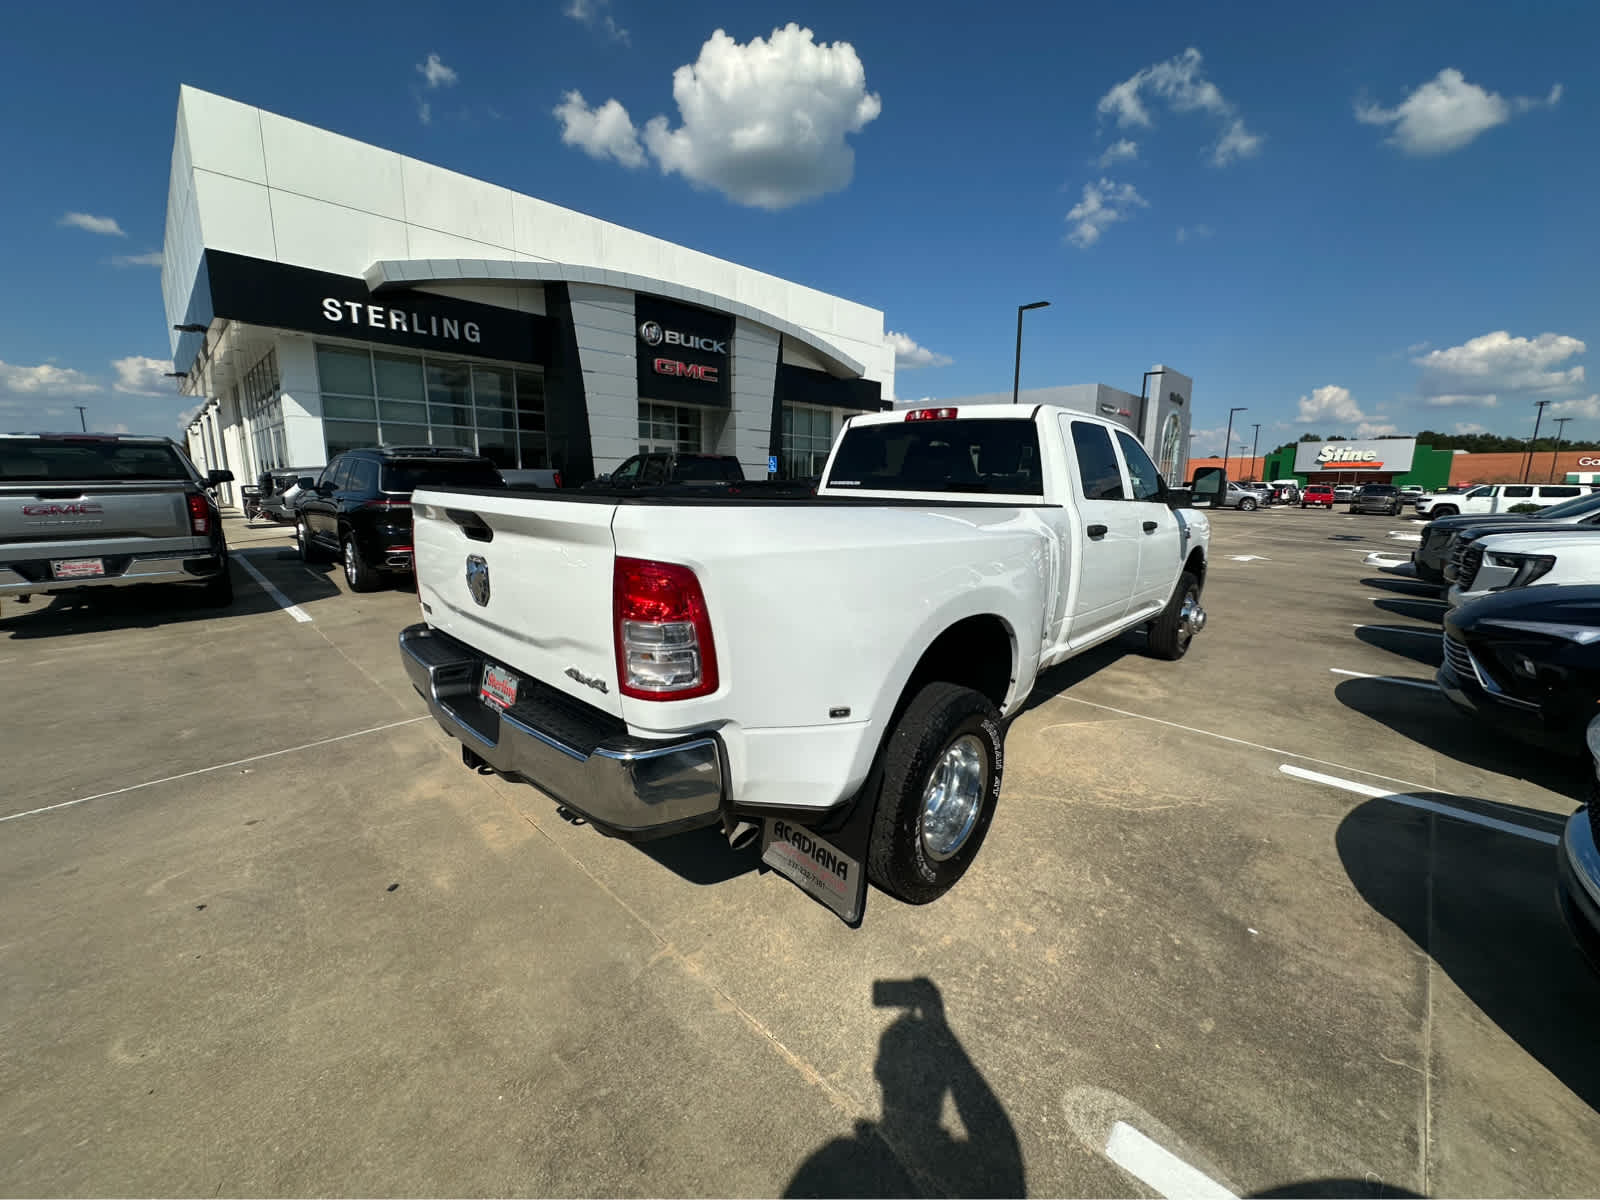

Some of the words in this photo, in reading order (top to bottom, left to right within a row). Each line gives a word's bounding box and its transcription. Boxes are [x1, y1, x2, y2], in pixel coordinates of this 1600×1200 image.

[322, 297, 481, 343] STERLING
[665, 330, 727, 354] BUICK
[655, 358, 718, 382] GMC
[1317, 445, 1377, 463] Stine
[774, 821, 848, 880] ACADIANA
